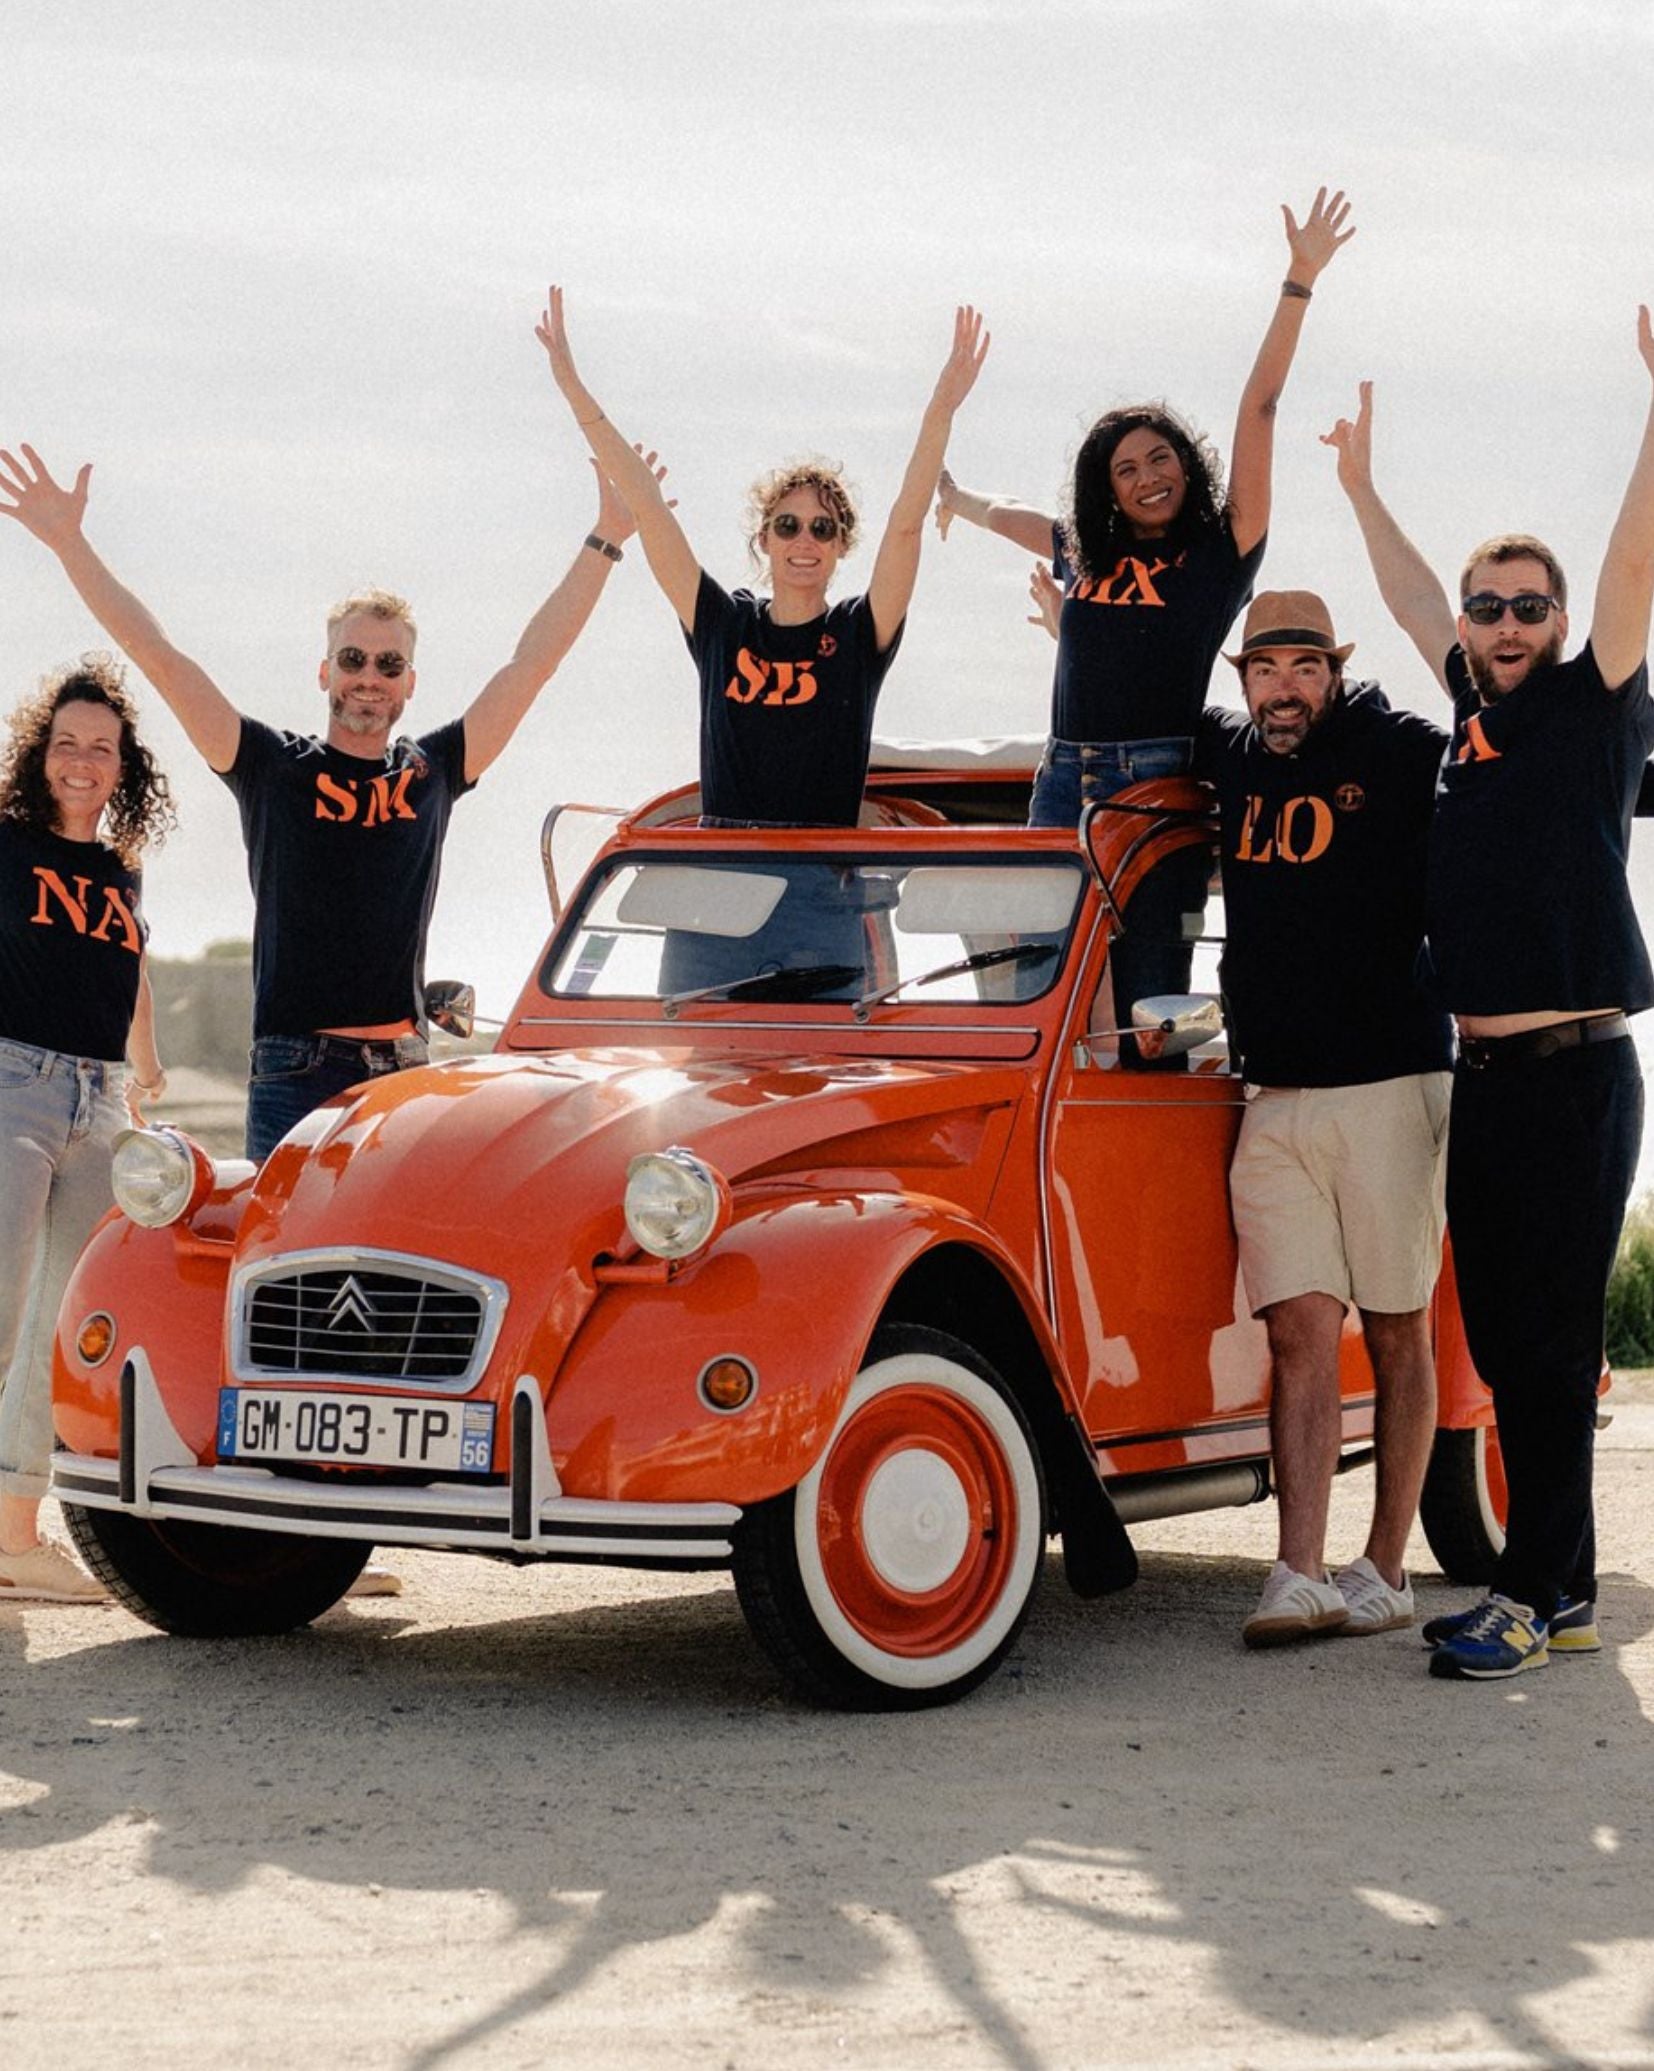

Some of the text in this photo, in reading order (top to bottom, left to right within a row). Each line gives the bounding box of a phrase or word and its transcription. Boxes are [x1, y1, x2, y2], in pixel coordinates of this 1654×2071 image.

[315, 768, 417, 827] SM
[1235, 795, 1334, 863] LO
[30, 866, 141, 954] NA
[223, 1431, 231, 1446] F
[462, 1439, 489, 1466] 56
